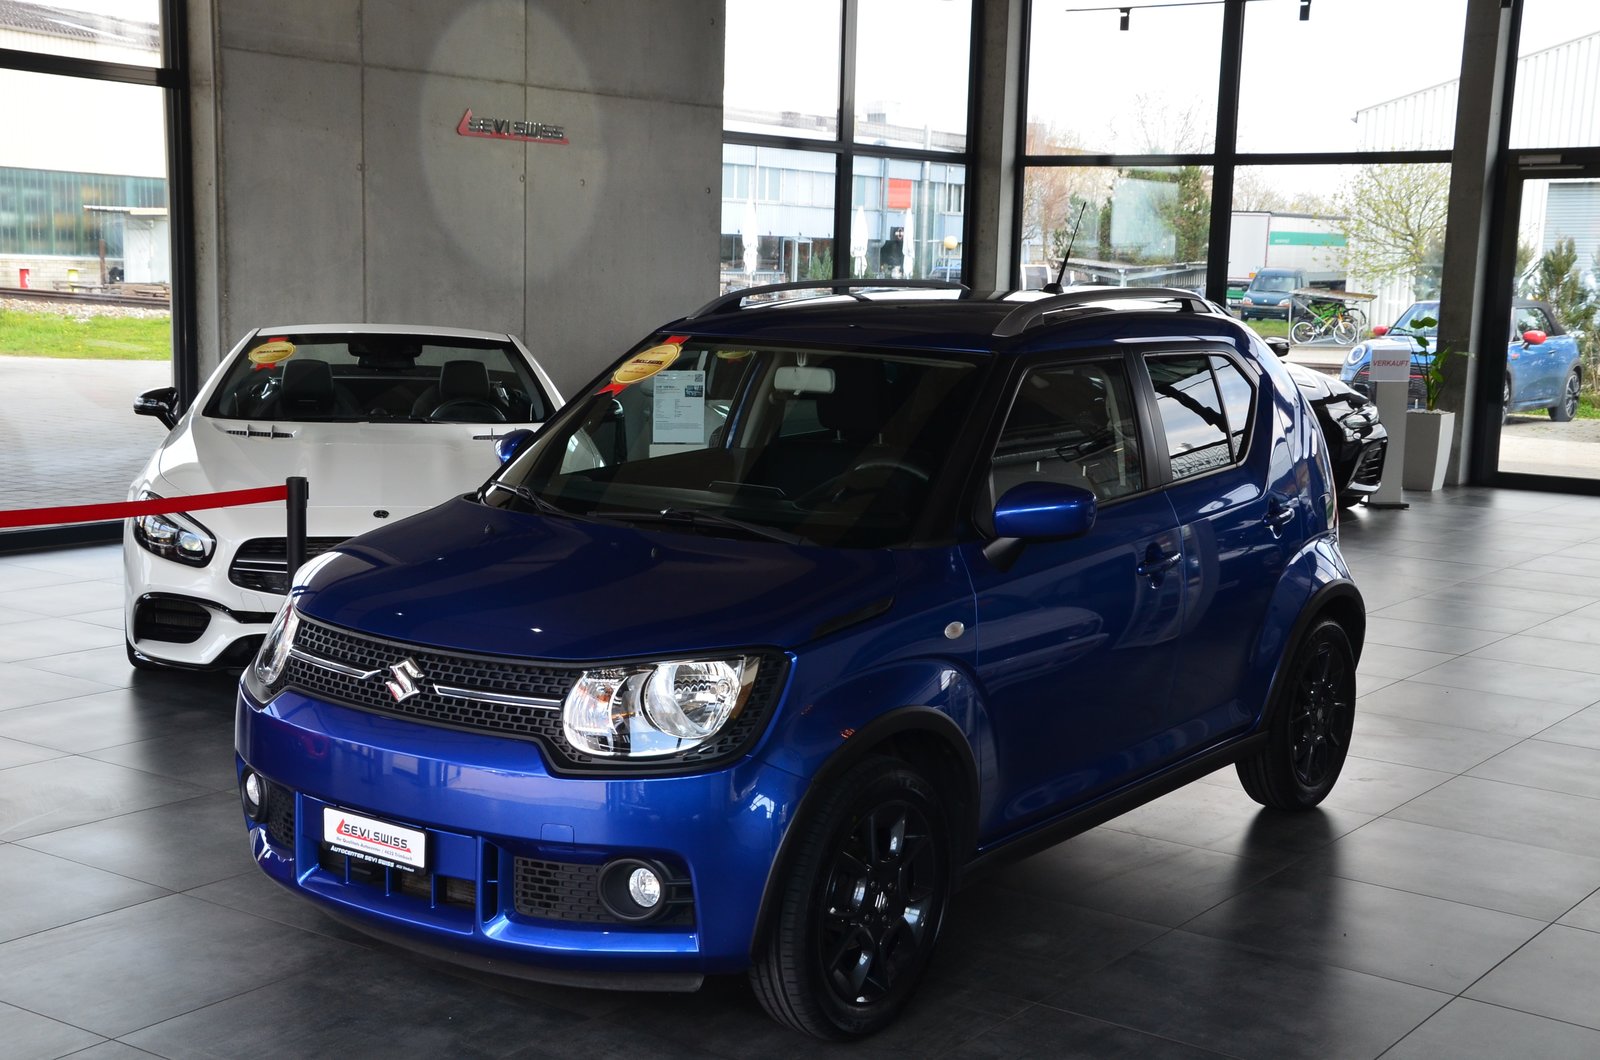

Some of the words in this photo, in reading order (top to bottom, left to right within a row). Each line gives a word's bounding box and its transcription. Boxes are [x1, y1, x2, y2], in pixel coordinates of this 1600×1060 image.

[467, 117, 511, 136] SEVI
[513, 121, 564, 139] SWISS
[1373, 359, 1409, 367] VERKAUFT
[343, 823, 370, 838] SEVI
[373, 831, 408, 849] SWISS
